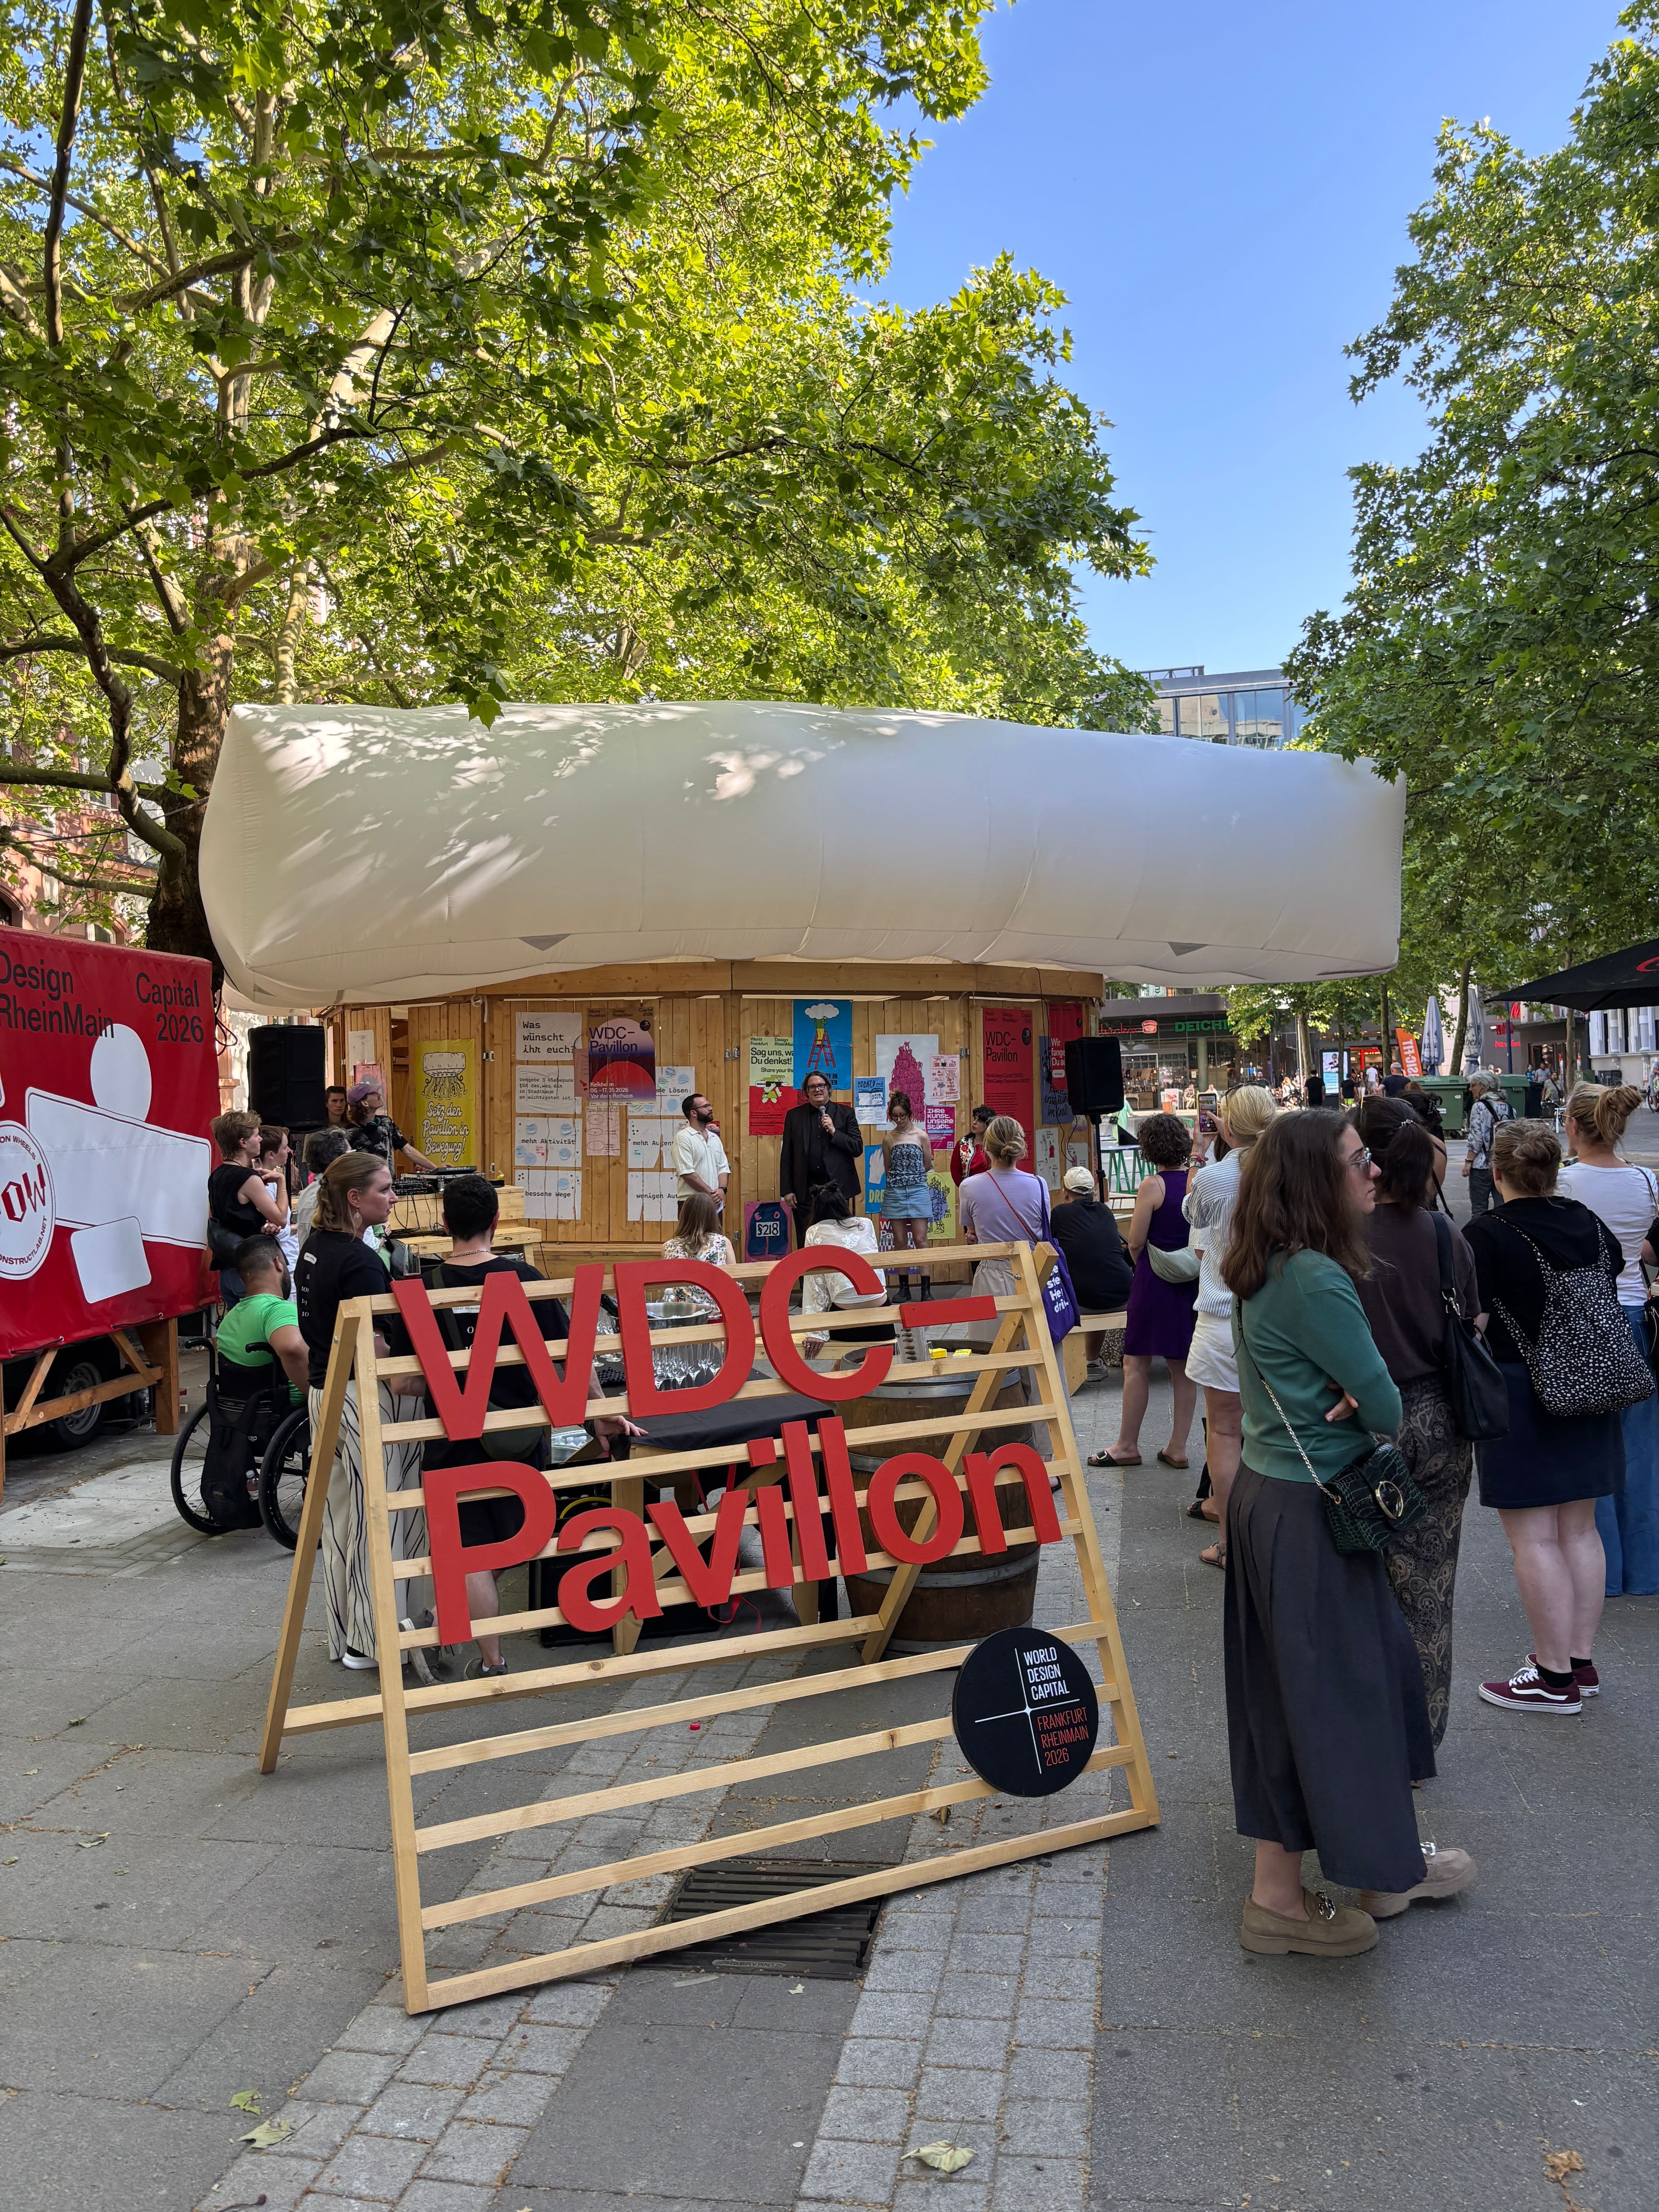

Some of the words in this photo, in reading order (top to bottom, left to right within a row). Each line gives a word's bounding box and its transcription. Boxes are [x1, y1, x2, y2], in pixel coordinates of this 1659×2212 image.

[0, 952, 73, 1001] Design
[136, 973, 200, 1012] Capital
[0, 994, 114, 1038] RheinMain
[156, 1014, 204, 1043] 2026
[590, 1040, 637, 1052] Pavillon
[1051, 1038, 1060, 1046] Wir
[751, 1048, 766, 1057] Sag
[986, 1047, 1018, 1062] Pavillon
[427, 1101, 445, 1122] Setz
[446, 1102, 462, 1117] den
[422, 1119, 458, 1138] Pavillon
[459, 1122, 469, 1136] in
[13, 1135, 35, 1160] WHEELS
[424, 1137, 466, 1162] Bewegung!
[757, 1223, 778, 1235] §218
[423, 1416, 1062, 1646] Pavillon
[1023, 1647, 1057, 1665] WORLD
[1027, 1664, 1062, 1683] DESIGN
[1031, 1680, 1070, 1700] CAPITAL
[1037, 1707, 1087, 1731] FRANKFURT
[1041, 1726, 1089, 1748] RHEINMAIN
[1045, 1748, 1070, 1767] 2026
